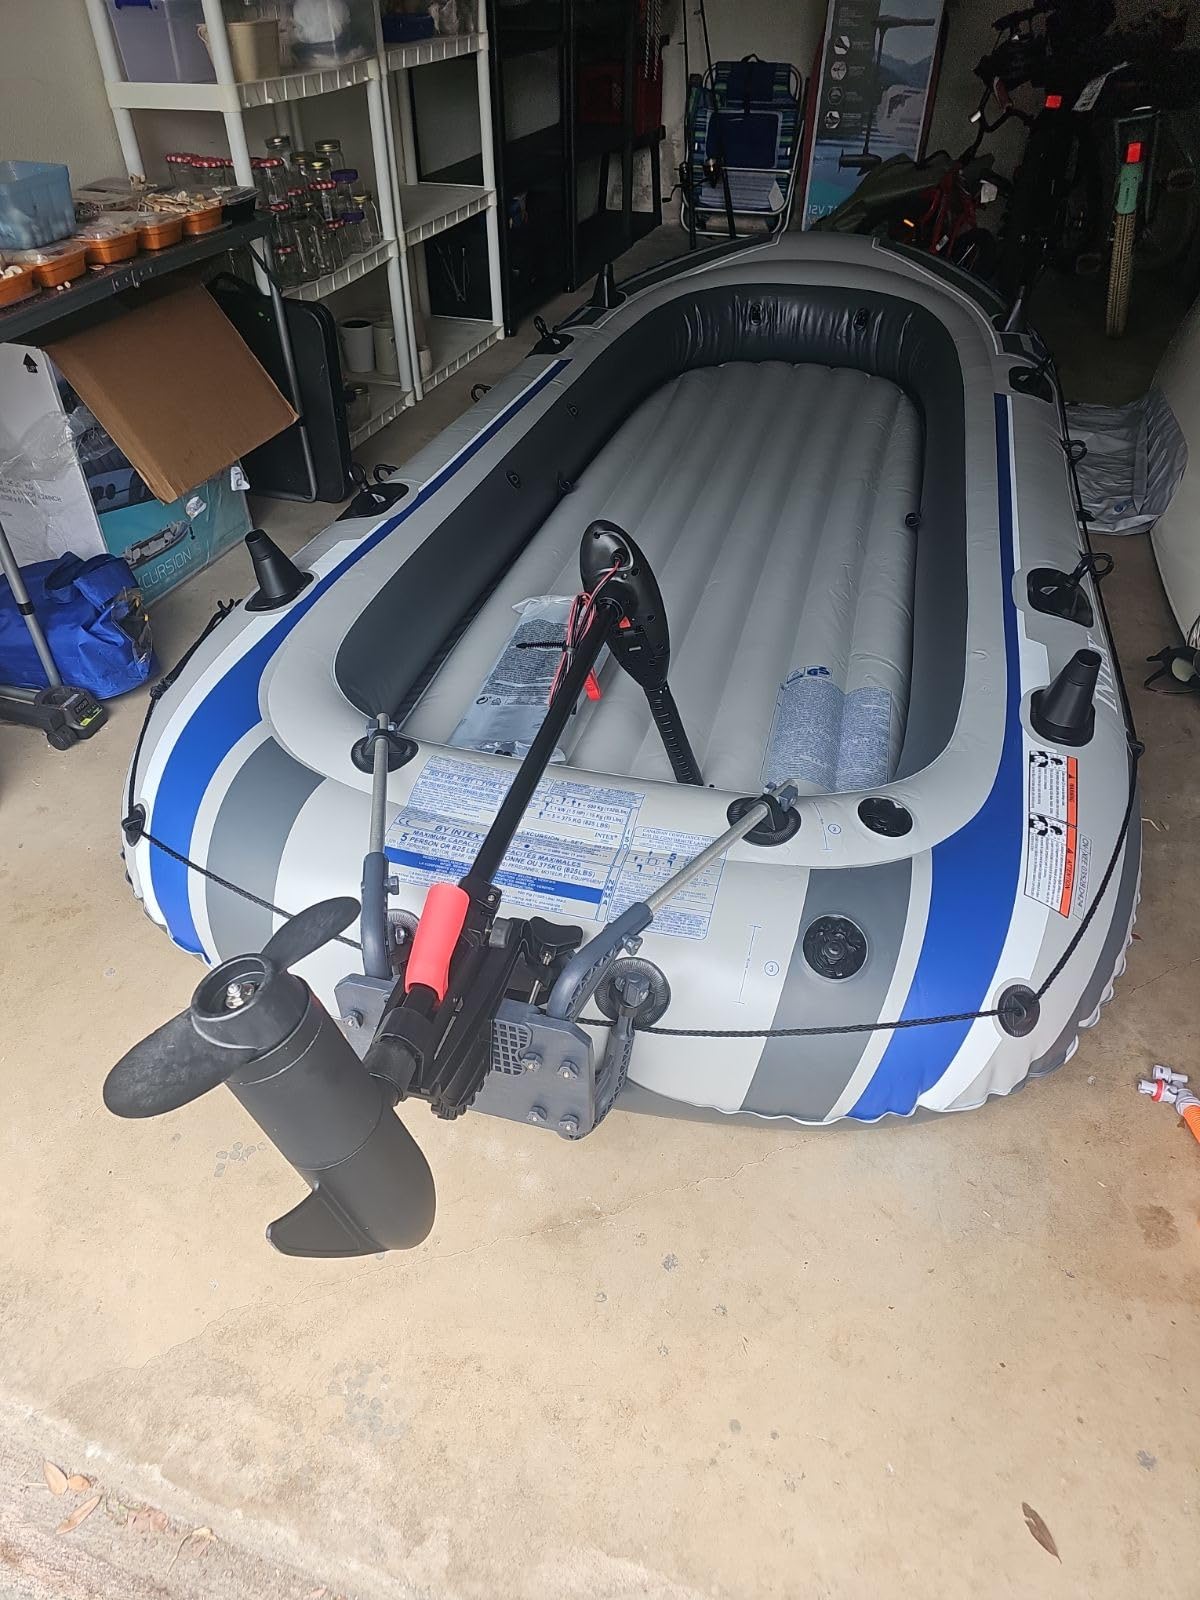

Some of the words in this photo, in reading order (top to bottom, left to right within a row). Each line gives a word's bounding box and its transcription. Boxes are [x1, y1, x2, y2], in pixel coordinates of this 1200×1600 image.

[434, 825, 450, 834] BY
[400, 832, 410, 842] 5
[413, 830, 448, 841] MAXIMUM
[410, 837, 439, 848] PERSON
[452, 845, 466, 853] 825
[504, 856, 525, 864] ONNE
[507, 849, 537, 860] ACITÉS
[538, 855, 581, 868] MAXIMALES
[1064, 861, 1073, 889] ATTENTION
